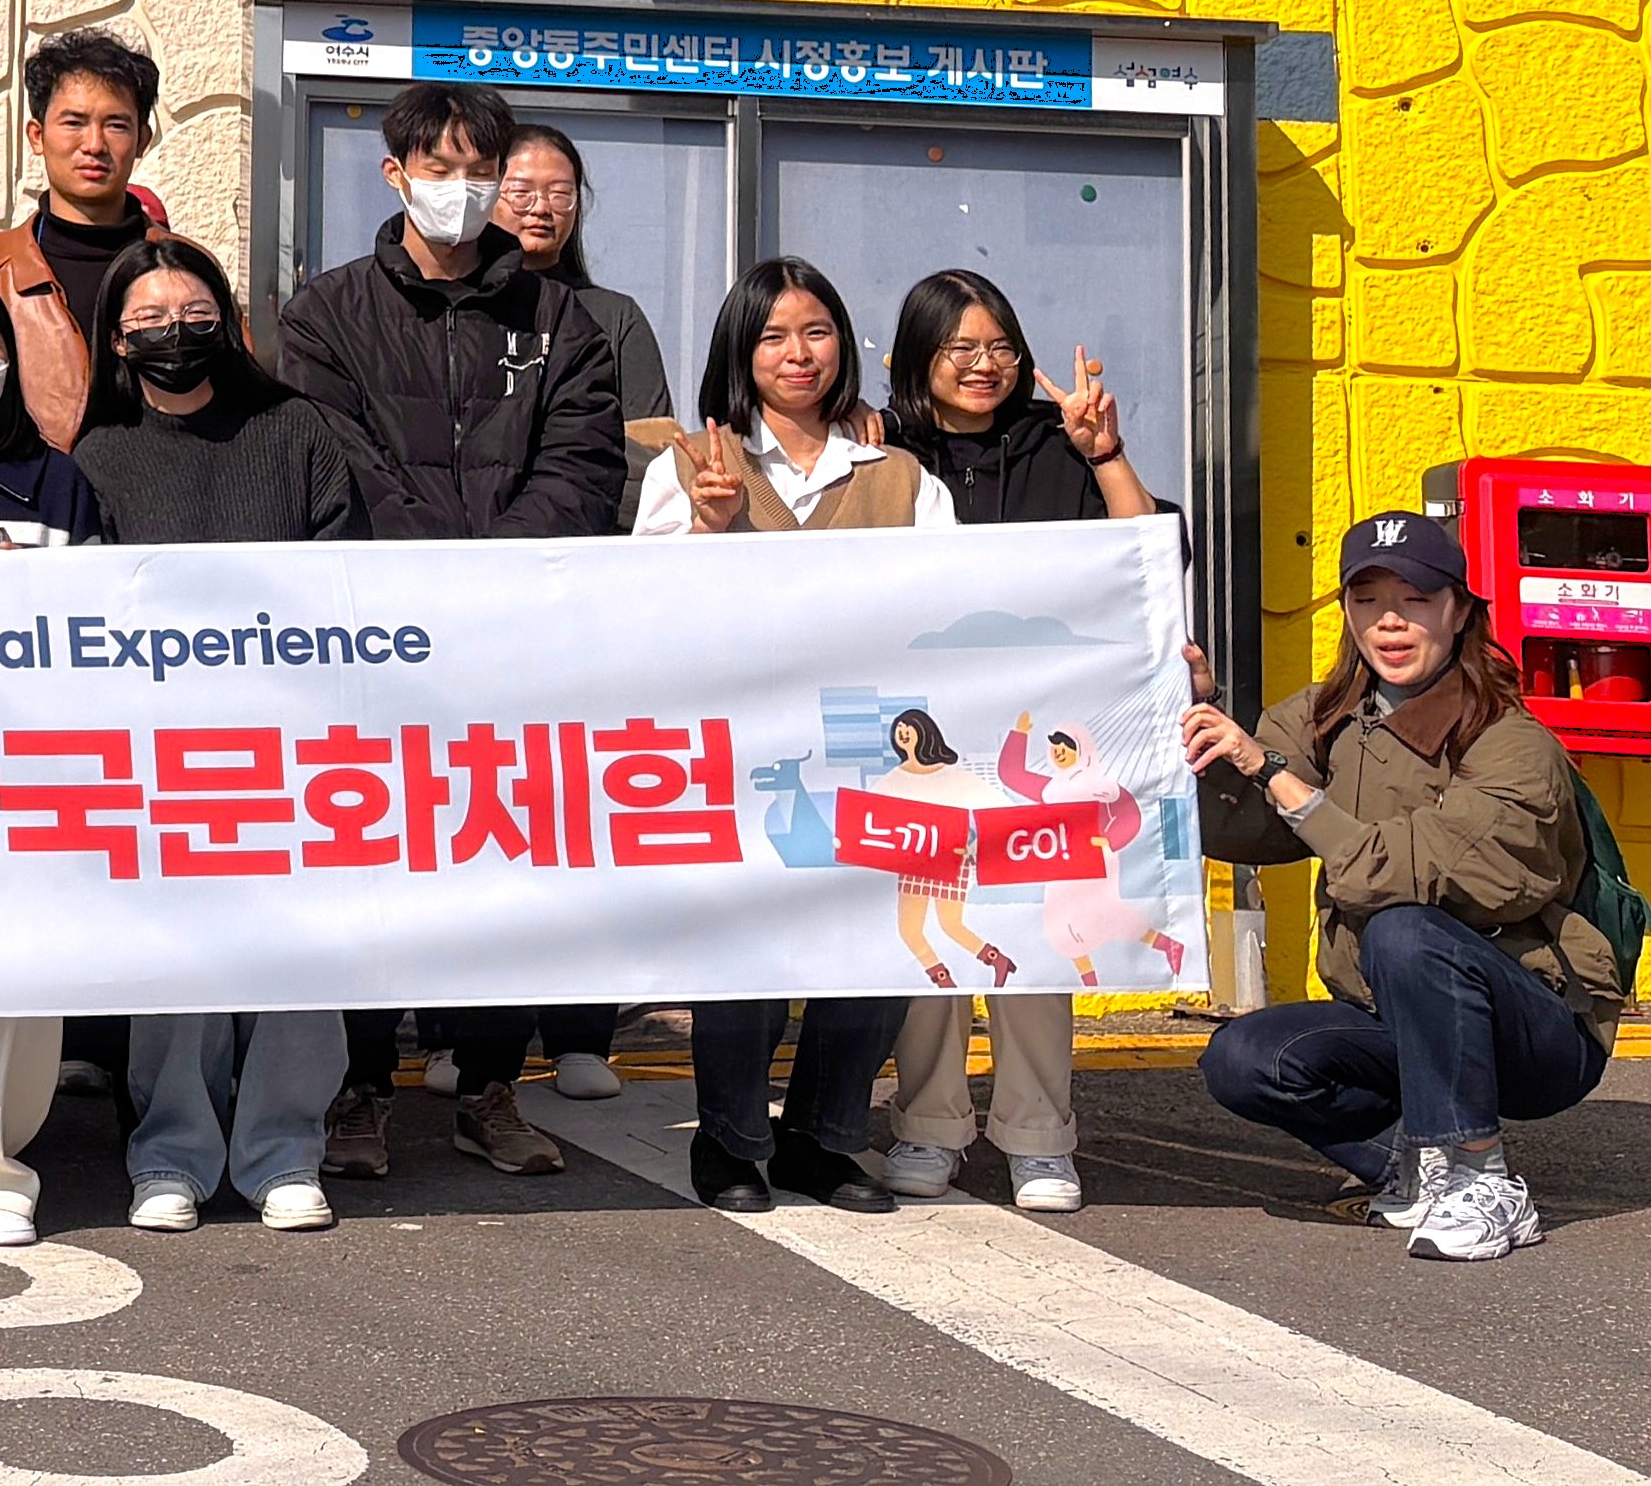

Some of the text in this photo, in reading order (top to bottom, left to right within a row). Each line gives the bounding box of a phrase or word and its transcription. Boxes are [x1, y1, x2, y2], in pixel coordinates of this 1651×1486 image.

[325, 45, 369, 58] 여수시
[462, 25, 1048, 90] 중앙동주민센터 시정홍보 게시판
[67, 612, 431, 682] Experience
[860, 811, 939, 857] 느끼
[1006, 822, 1070, 861] GO!
